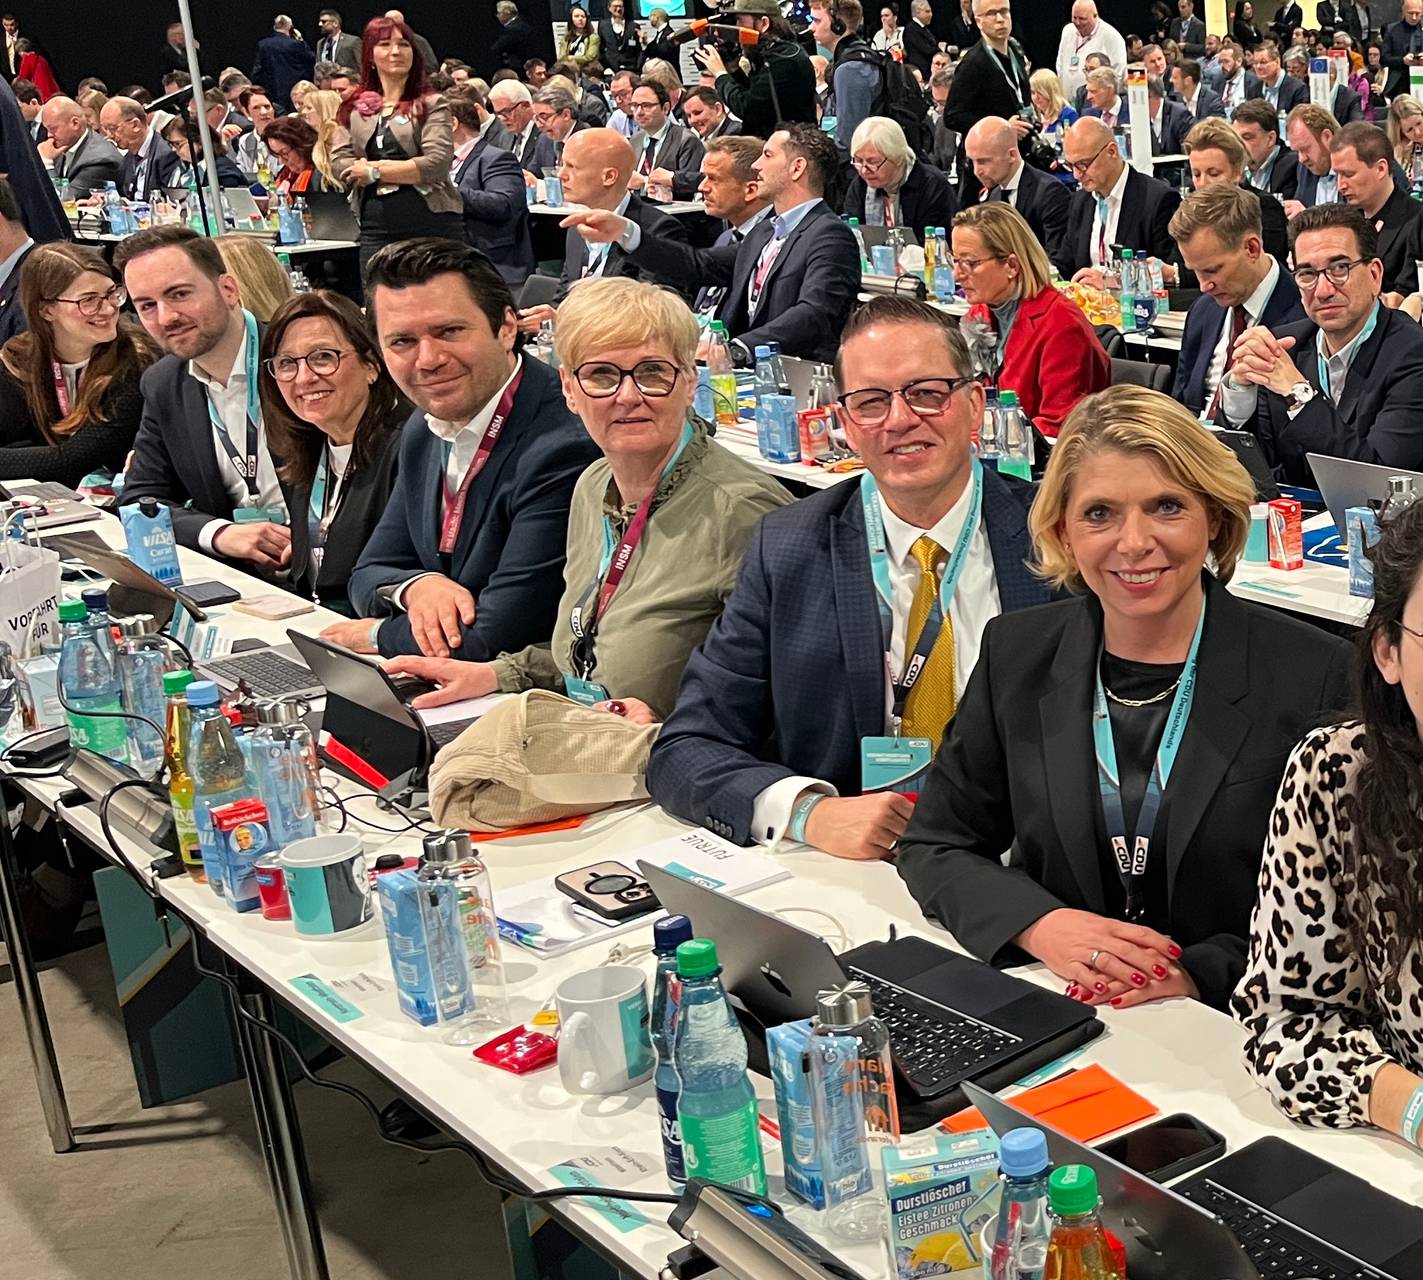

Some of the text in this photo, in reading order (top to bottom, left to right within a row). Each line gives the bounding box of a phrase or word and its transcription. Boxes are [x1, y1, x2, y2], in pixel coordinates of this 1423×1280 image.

[488, 414, 504, 438] INSM
[615, 543, 633, 571] INSM
[32, 622, 49, 642] FÜR
[572, 614, 583, 638] CDU
[906, 663, 919, 686] CDU
[1183, 679, 1194, 698] CDU
[1166, 697, 1189, 750] Deutschlands
[1116, 846, 1131, 870] CDU
[1134, 847, 1145, 873] CDU
[896, 1180, 967, 1212] Durstlöscher
[898, 1195, 977, 1227] Eistee Zitronen-
[899, 1214, 959, 1241] Geschmack
